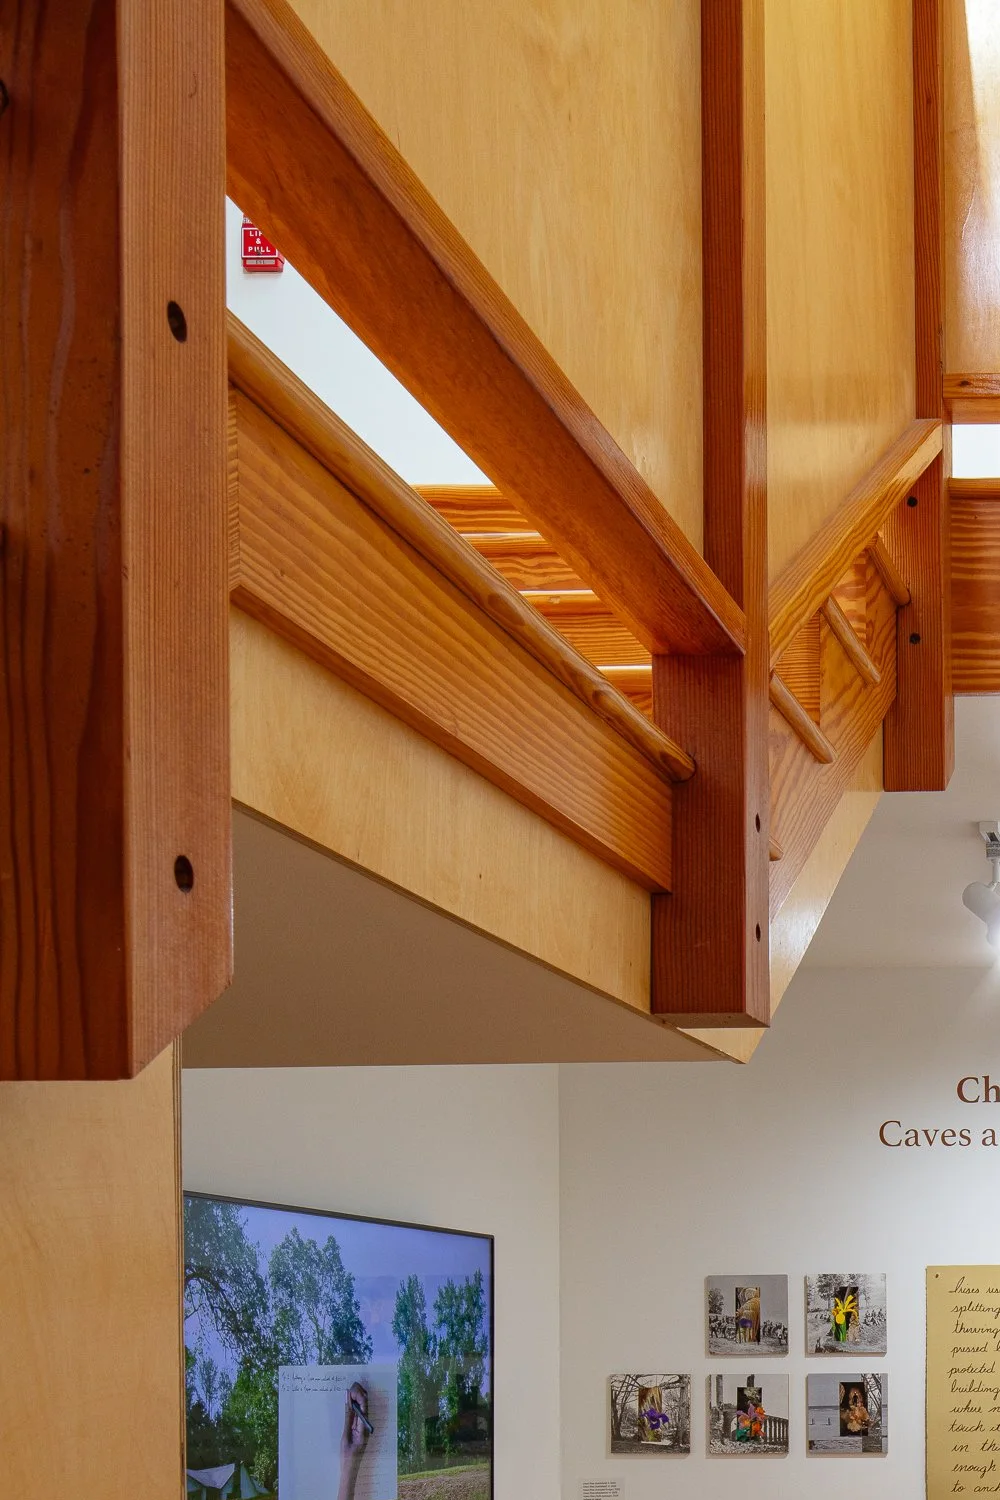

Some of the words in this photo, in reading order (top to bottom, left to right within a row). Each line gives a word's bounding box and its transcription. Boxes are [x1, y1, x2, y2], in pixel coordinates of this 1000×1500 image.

[879, 1120, 971, 1147] Caves
[948, 1277, 980, 1294] Irises
[951, 1342, 988, 1357] pressed
[947, 1362, 995, 1378] protected
[950, 1400, 982, 1414] where
[948, 1420, 985, 1433] touch
[951, 1444, 969, 1453] in
[951, 1459, 997, 1479] enough
[950, 1480, 966, 1493] to
